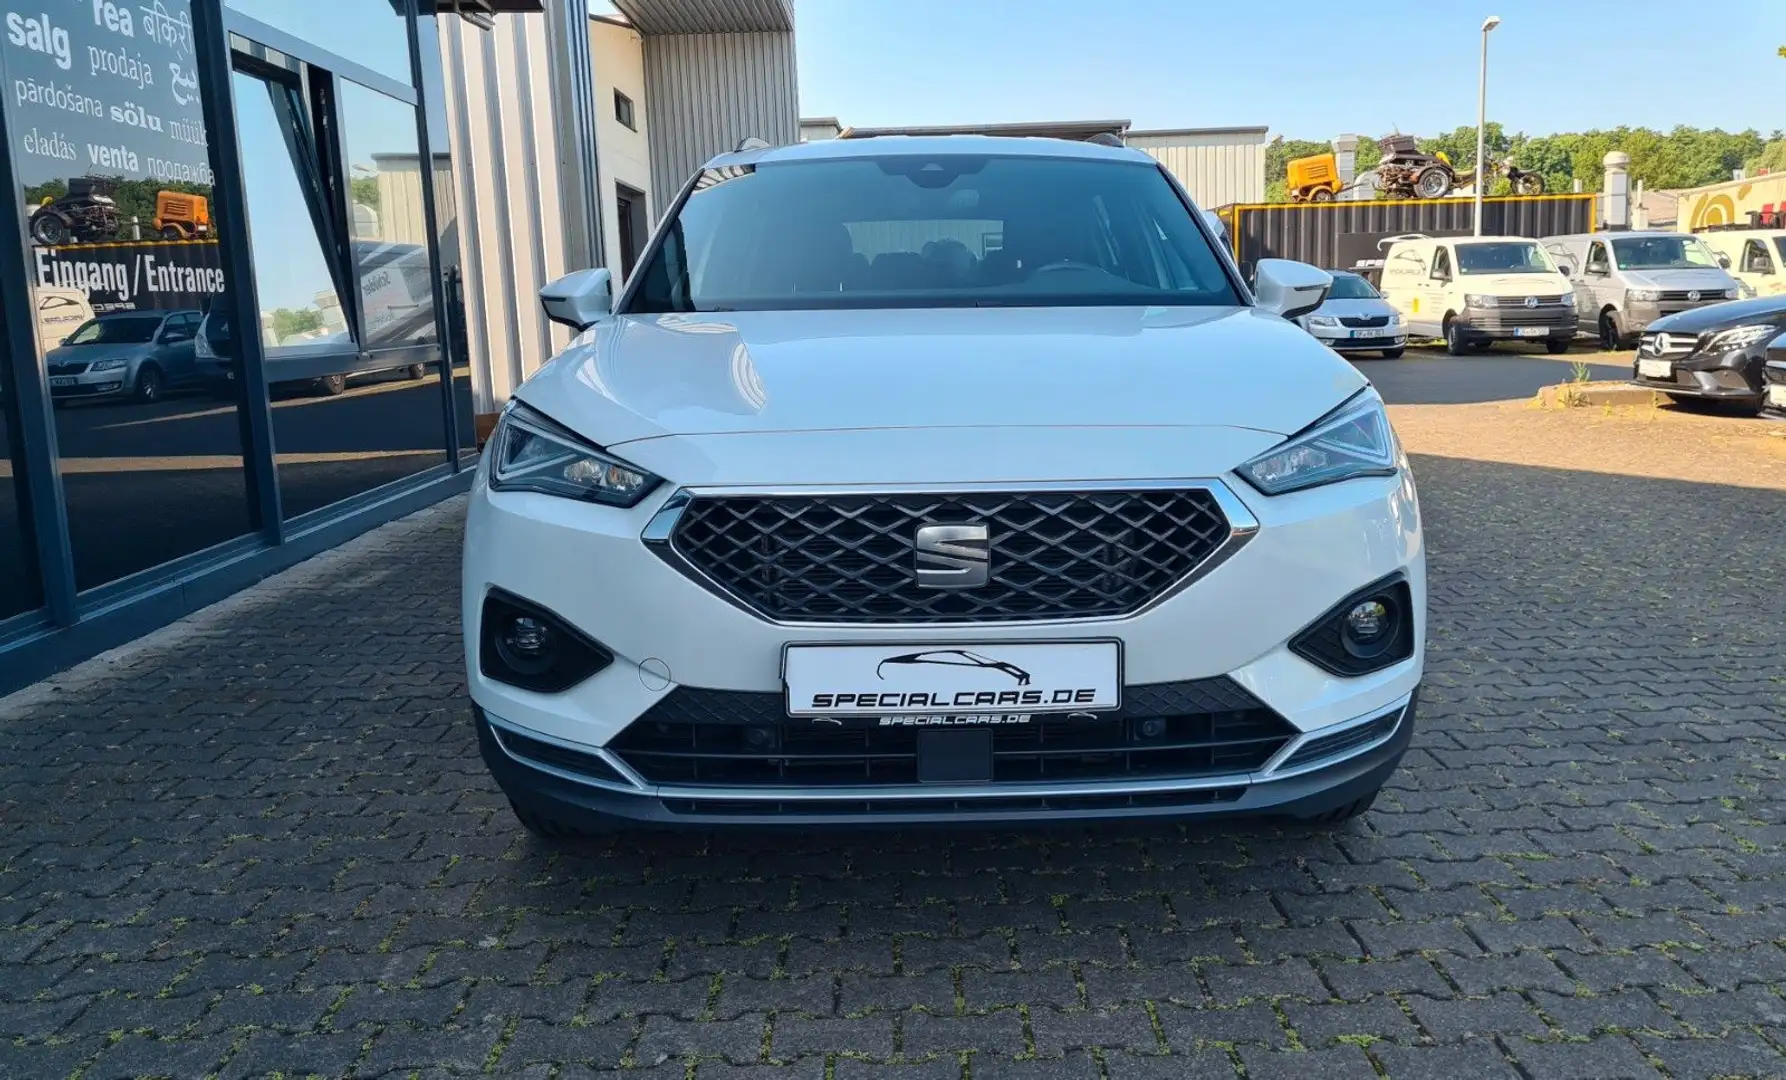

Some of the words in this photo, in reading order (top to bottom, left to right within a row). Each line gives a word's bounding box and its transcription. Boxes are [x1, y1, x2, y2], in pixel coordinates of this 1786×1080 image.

[6, 12, 72, 70] salg
[87, 45, 153, 89] prodaja
[15, 78, 103, 117] pārdošana
[110, 101, 164, 132] sölu
[24, 128, 77, 161] eladás
[87, 143, 139, 172] venta
[147, 157, 215, 187] продажба
[35, 247, 129, 301] Eingang
[145, 254, 225, 293] Entrance
[812, 688, 1096, 708] SPECIALCARS.DE
[878, 714, 1032, 726] SPECIALCARS.DE
